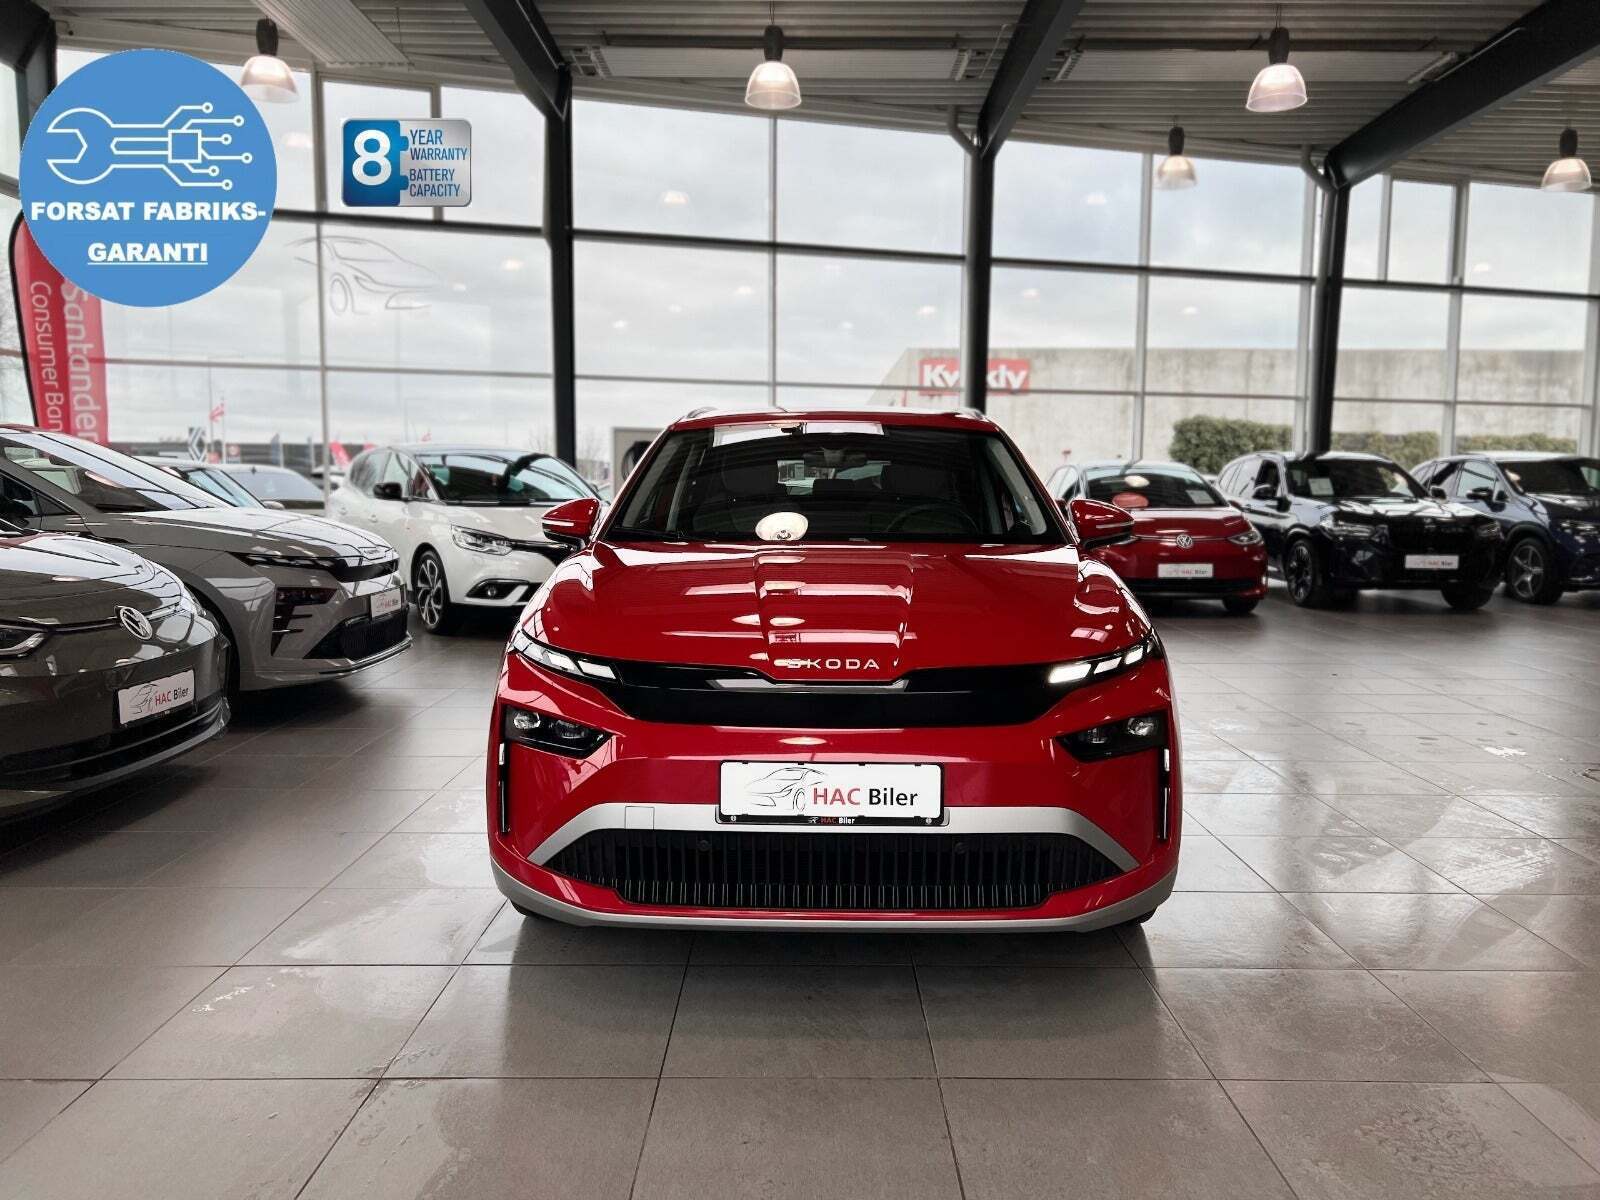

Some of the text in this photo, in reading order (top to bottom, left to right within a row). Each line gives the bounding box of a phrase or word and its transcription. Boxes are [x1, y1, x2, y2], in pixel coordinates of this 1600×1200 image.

[30, 281, 64, 432] Consumer Ban
[154, 687, 189, 707] HAC Biler
[813, 787, 918, 806] HAC Biler
[838, 816, 855, 824] Biler
